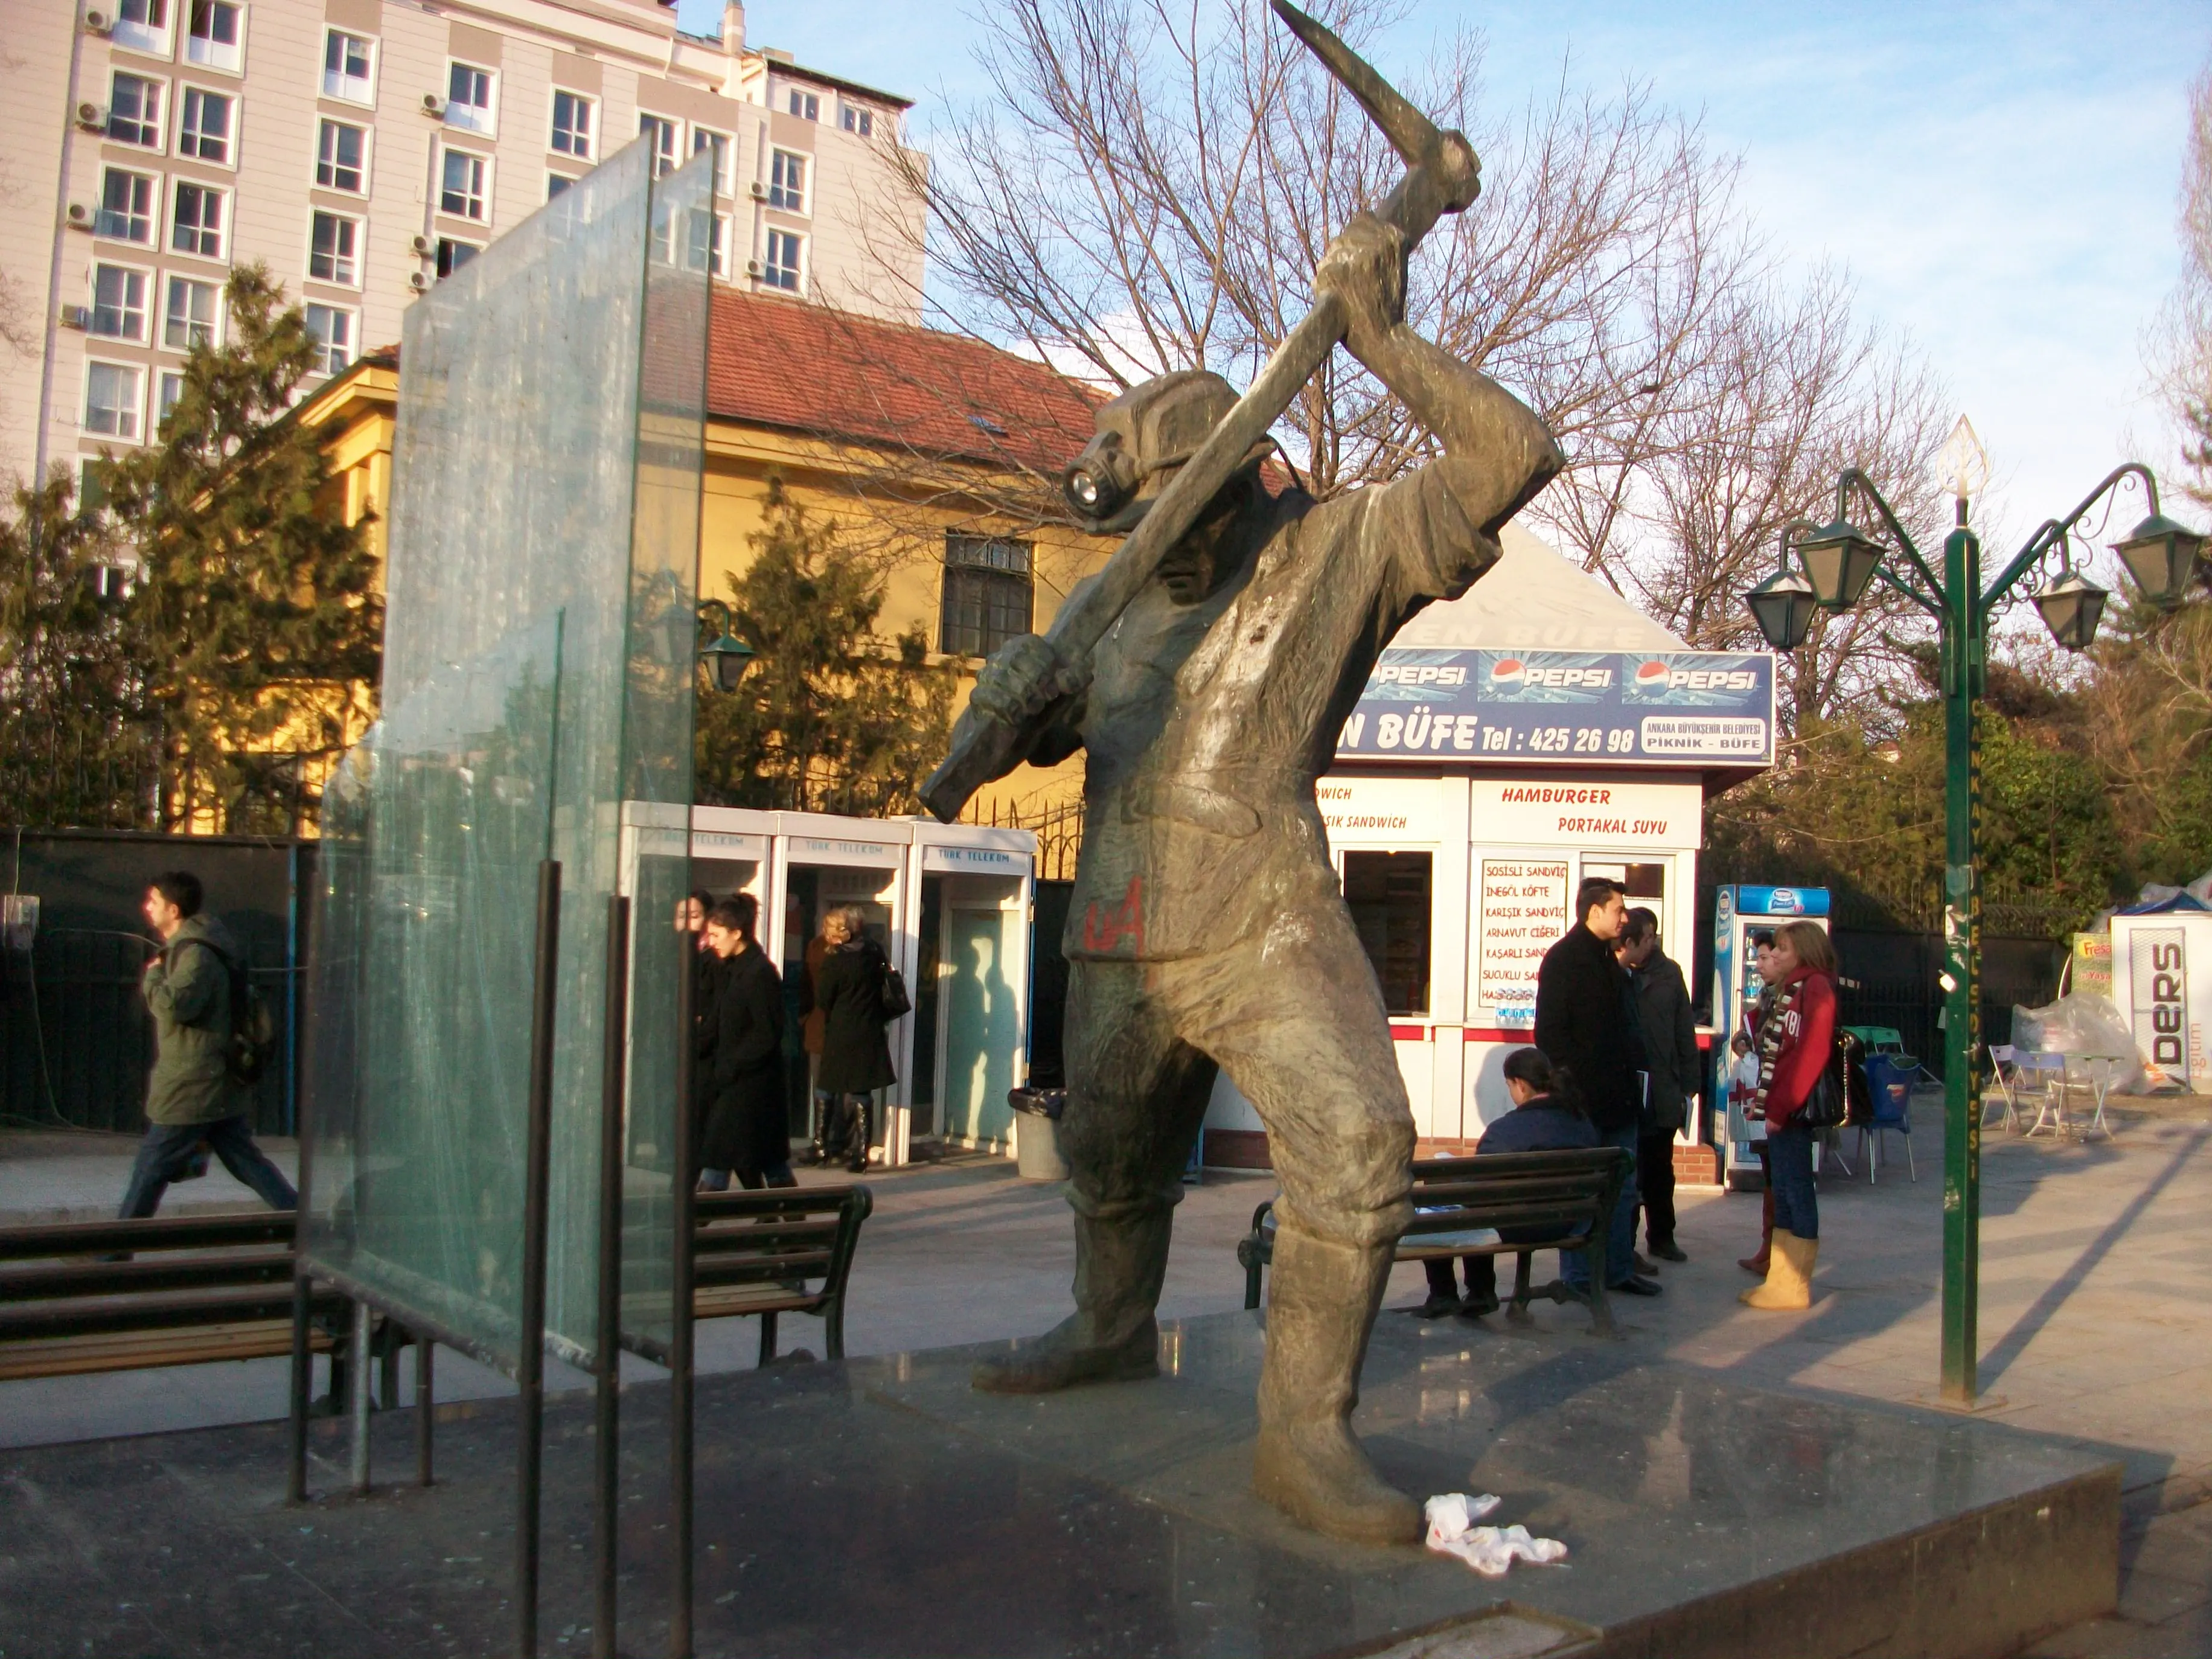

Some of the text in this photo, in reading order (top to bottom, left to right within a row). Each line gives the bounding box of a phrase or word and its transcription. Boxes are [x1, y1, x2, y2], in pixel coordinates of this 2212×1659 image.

[1379, 666, 1468, 685] PEPSI
[1524, 668, 1613, 687] PEPSI
[1668, 671, 1757, 689] PEPSI
[1376, 706, 1478, 750] BÜFE
[1529, 728, 1570, 751] 425
[1573, 729, 1602, 752] 26
[1606, 729, 1634, 753] 98
[1647, 723, 1675, 734] ANKARA
[1723, 722, 1760, 735] BELEDİYESİ
[1648, 737, 1702, 748] PİKNİK
[1721, 738, 1760, 749] BÜFE
[1501, 788, 1611, 805] HAMBURGER
[1558, 817, 1667, 834] PORTAKAL SUYU
[968, 851, 1009, 863] TELEKOM
[1486, 865, 1566, 878] SOSİSLİ SANDVİÇ
[1486, 884, 1549, 897] İNEGÖL KÖFTE
[1486, 906, 1564, 919] KARIŞIK SANDVİÇ
[1486, 928, 1527, 938] ARNAVUT
[1486, 949, 1523, 959] KAŞARLI
[1483, 970, 1520, 980] SUCUKLU
[2153, 943, 2181, 1064] DERS
